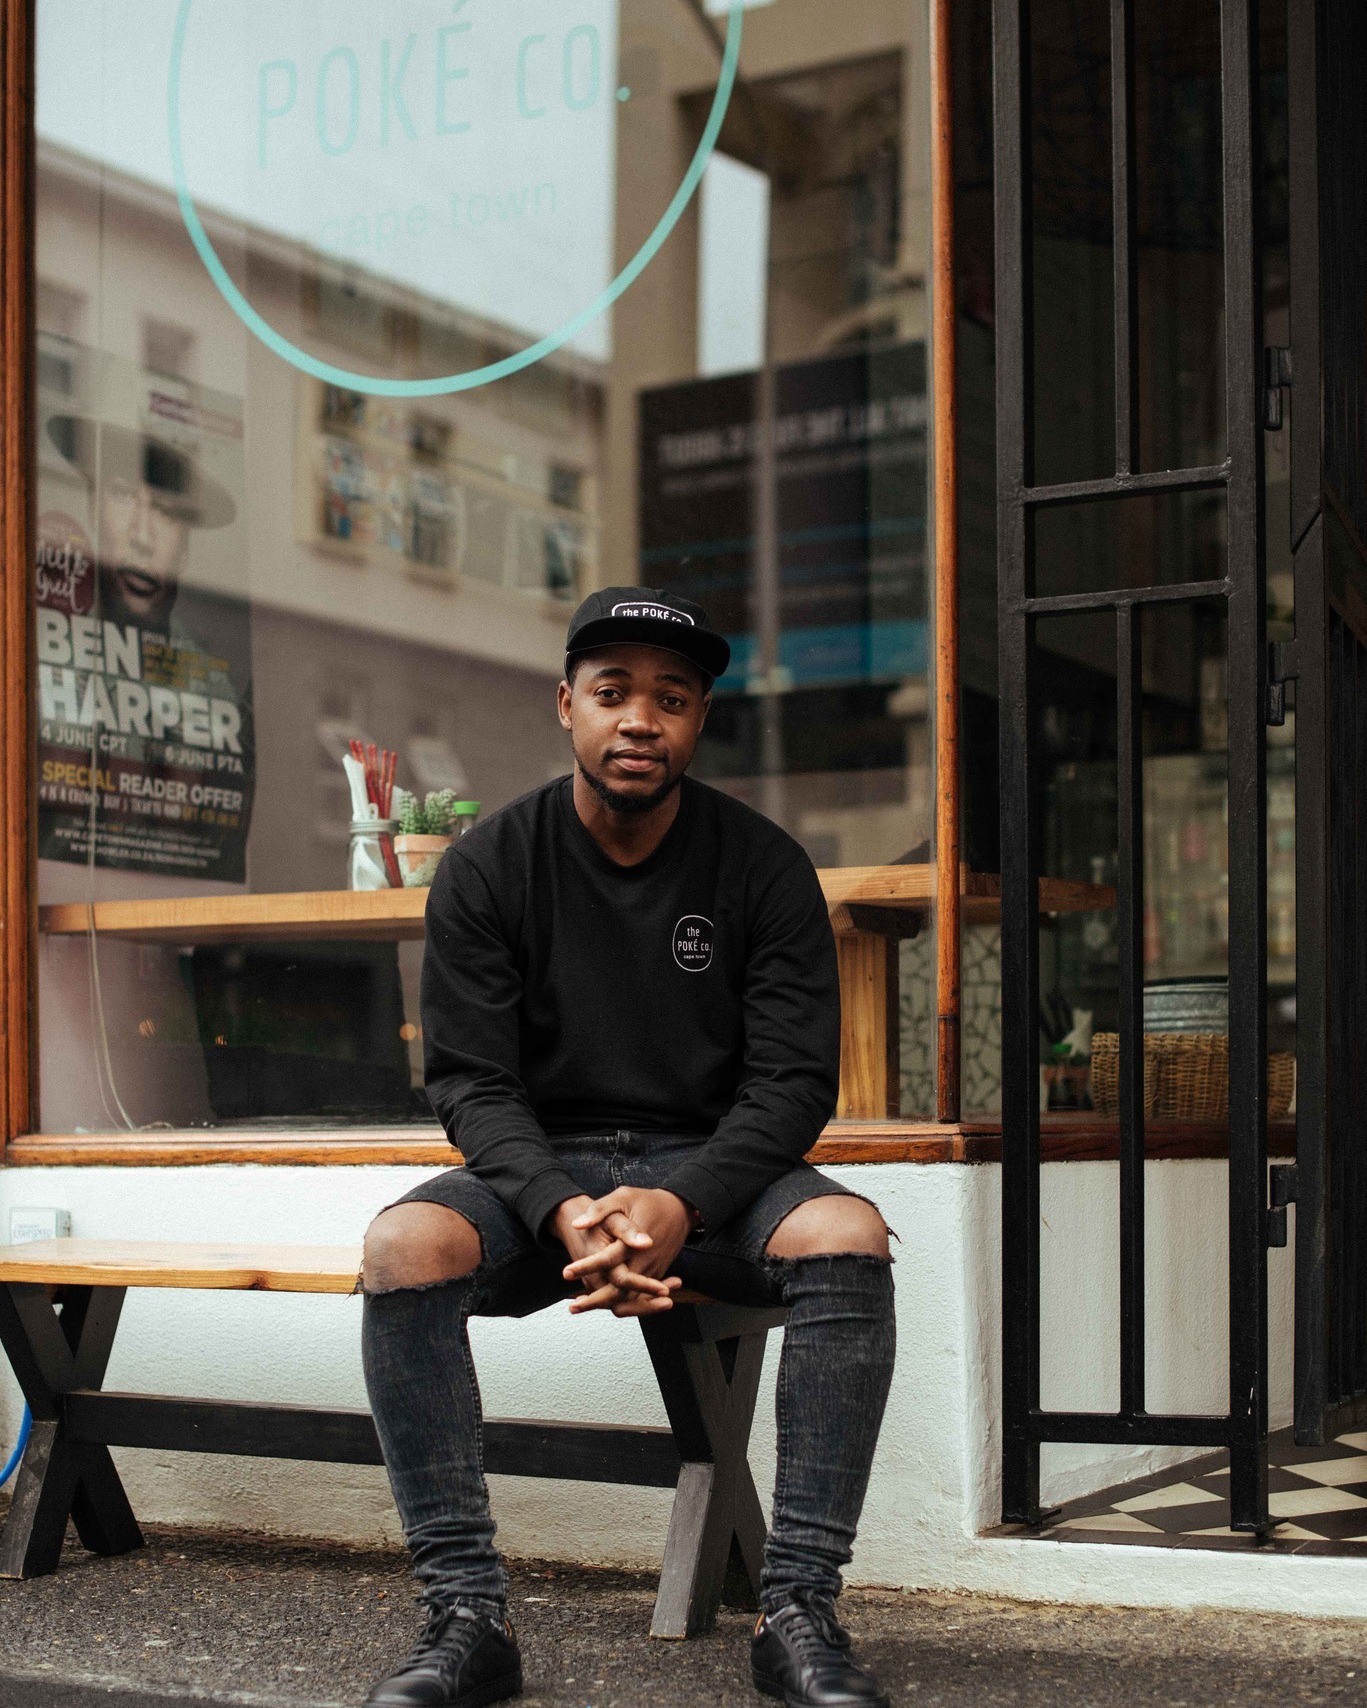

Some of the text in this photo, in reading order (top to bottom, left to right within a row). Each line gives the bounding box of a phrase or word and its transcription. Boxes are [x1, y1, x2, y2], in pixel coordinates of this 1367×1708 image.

[256, 0, 473, 170] POKÉ
[320, 182, 557, 252] cape town
[622, 608, 639, 617] the
[642, 607, 670, 620] POKÉ
[39, 607, 142, 682] BEN
[39, 664, 243, 754] HARPER
[41, 724, 127, 753] 4 JUNE CPT
[42, 760, 117, 793] SPECIAL
[119, 771, 187, 805] READER
[190, 783, 242, 812] OFFER
[677, 939, 698, 952] POKÉ
[687, 926, 700, 937] the
